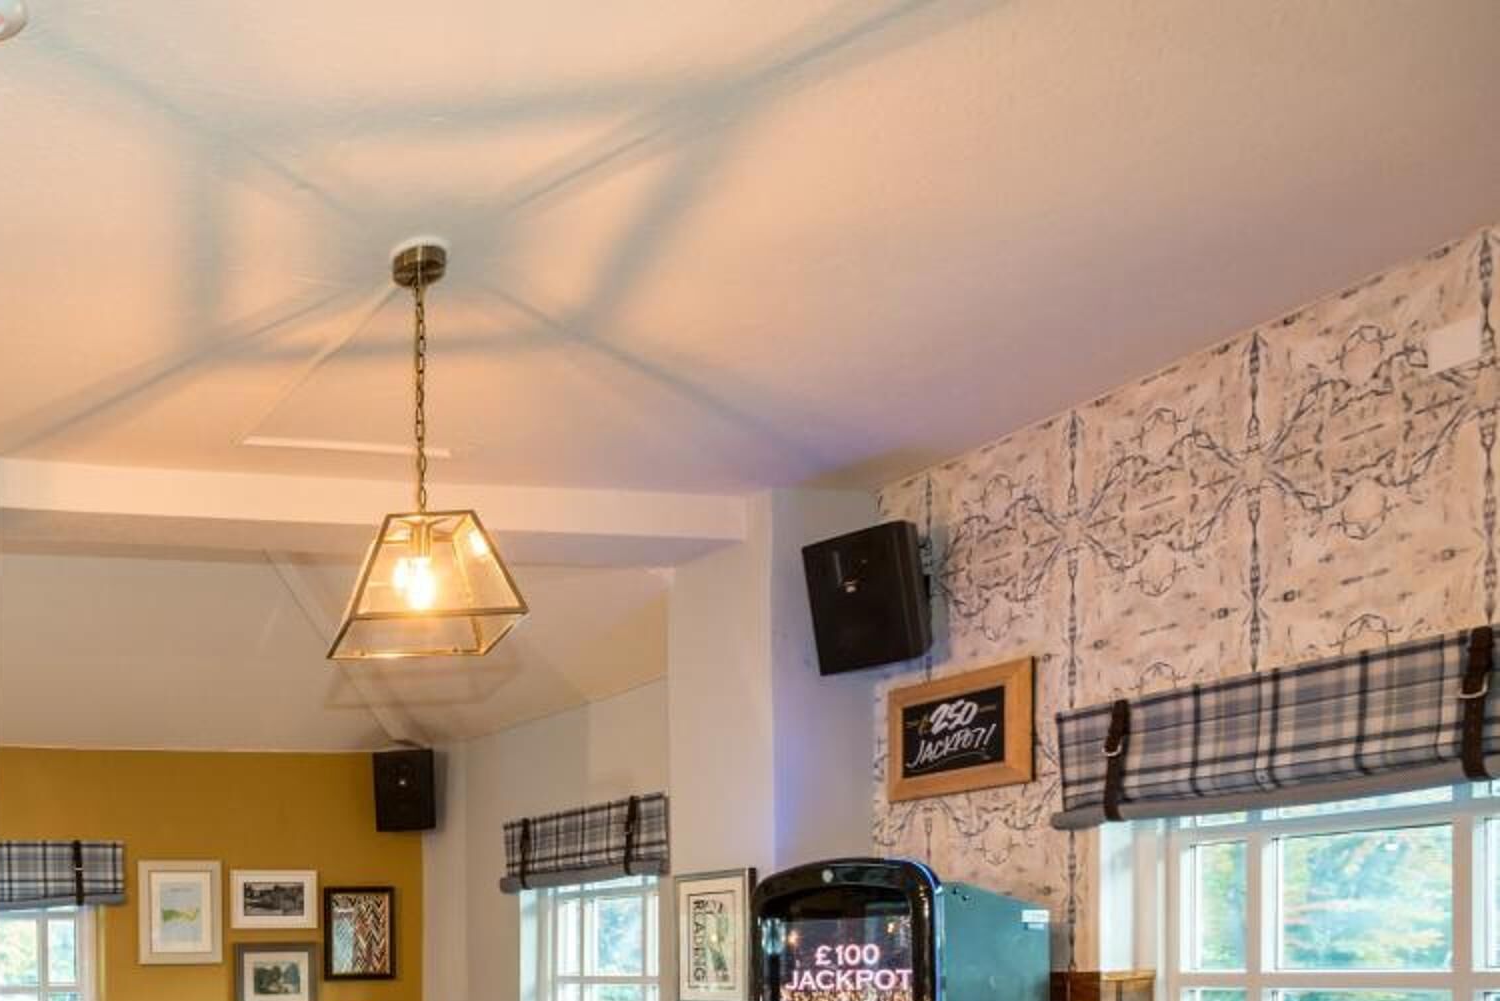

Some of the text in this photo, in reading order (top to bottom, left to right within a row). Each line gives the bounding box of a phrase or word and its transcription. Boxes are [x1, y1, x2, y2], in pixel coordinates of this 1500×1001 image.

[905, 723, 997, 768] JACKPOT!
[815, 943, 880, 966] £100
[785, 968, 913, 990] JACKPOT
